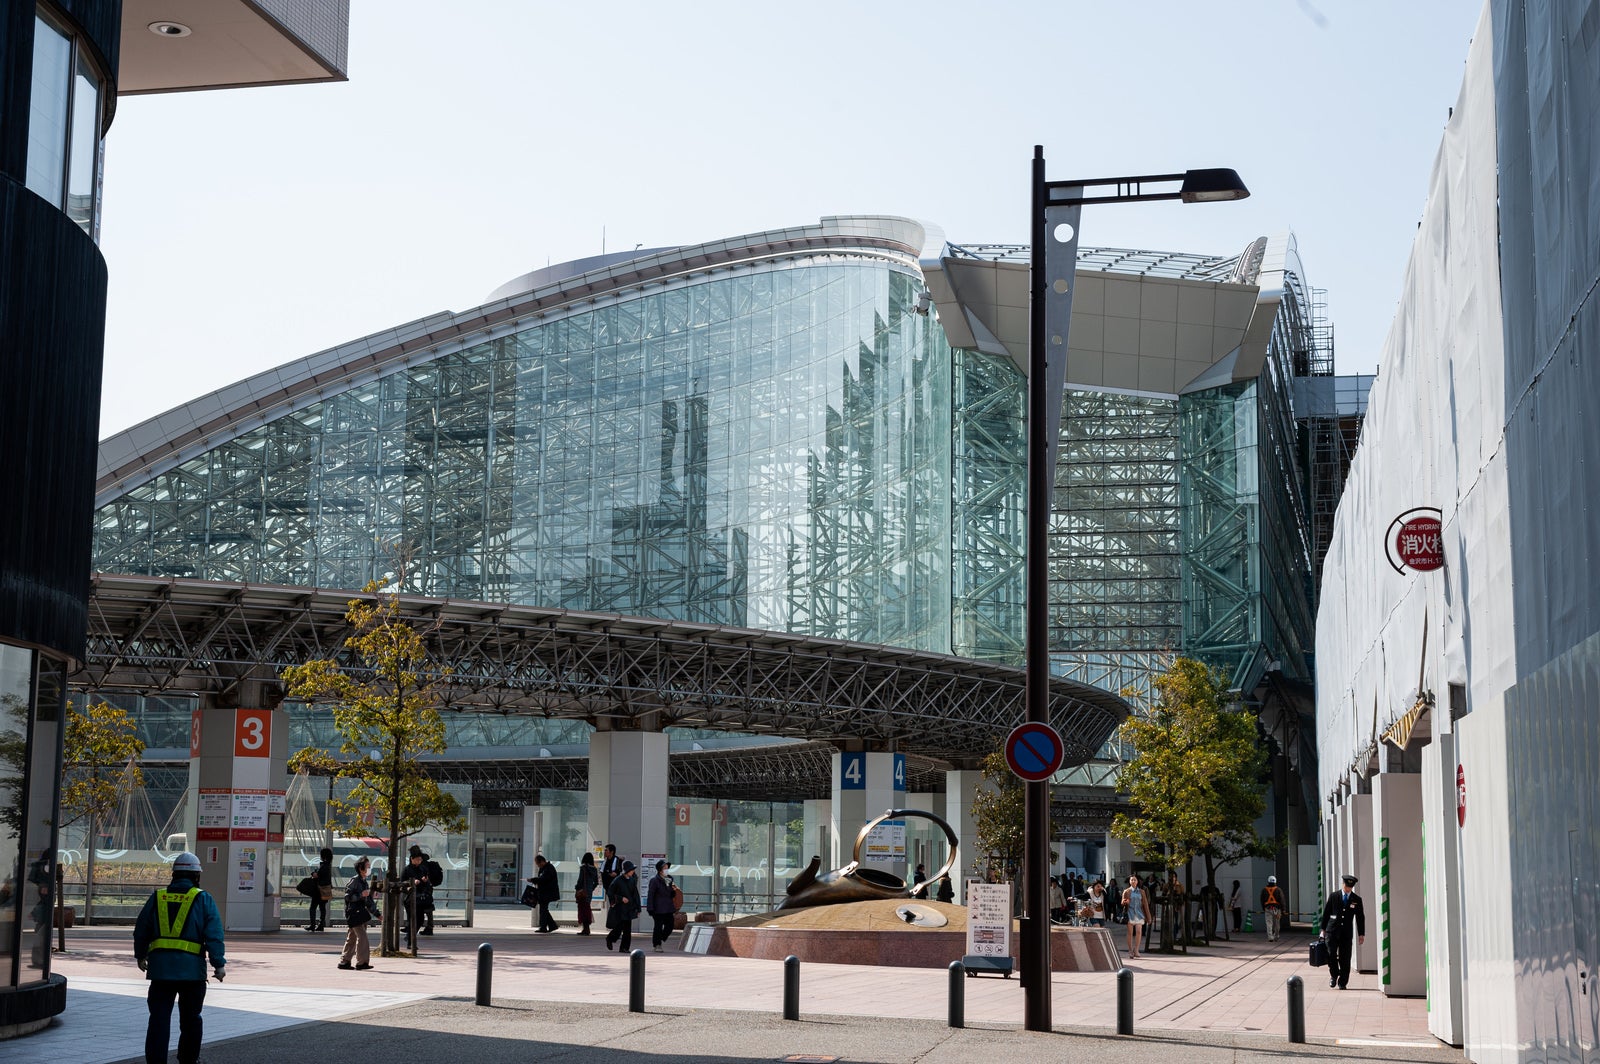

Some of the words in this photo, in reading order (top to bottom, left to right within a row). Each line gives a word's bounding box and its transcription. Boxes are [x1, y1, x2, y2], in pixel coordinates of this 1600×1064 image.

[192, 718, 200, 750] 3
[241, 717, 264, 750] 3
[845, 758, 862, 784] 4
[895, 760, 904, 785] 4
[679, 807, 687, 822] 6
